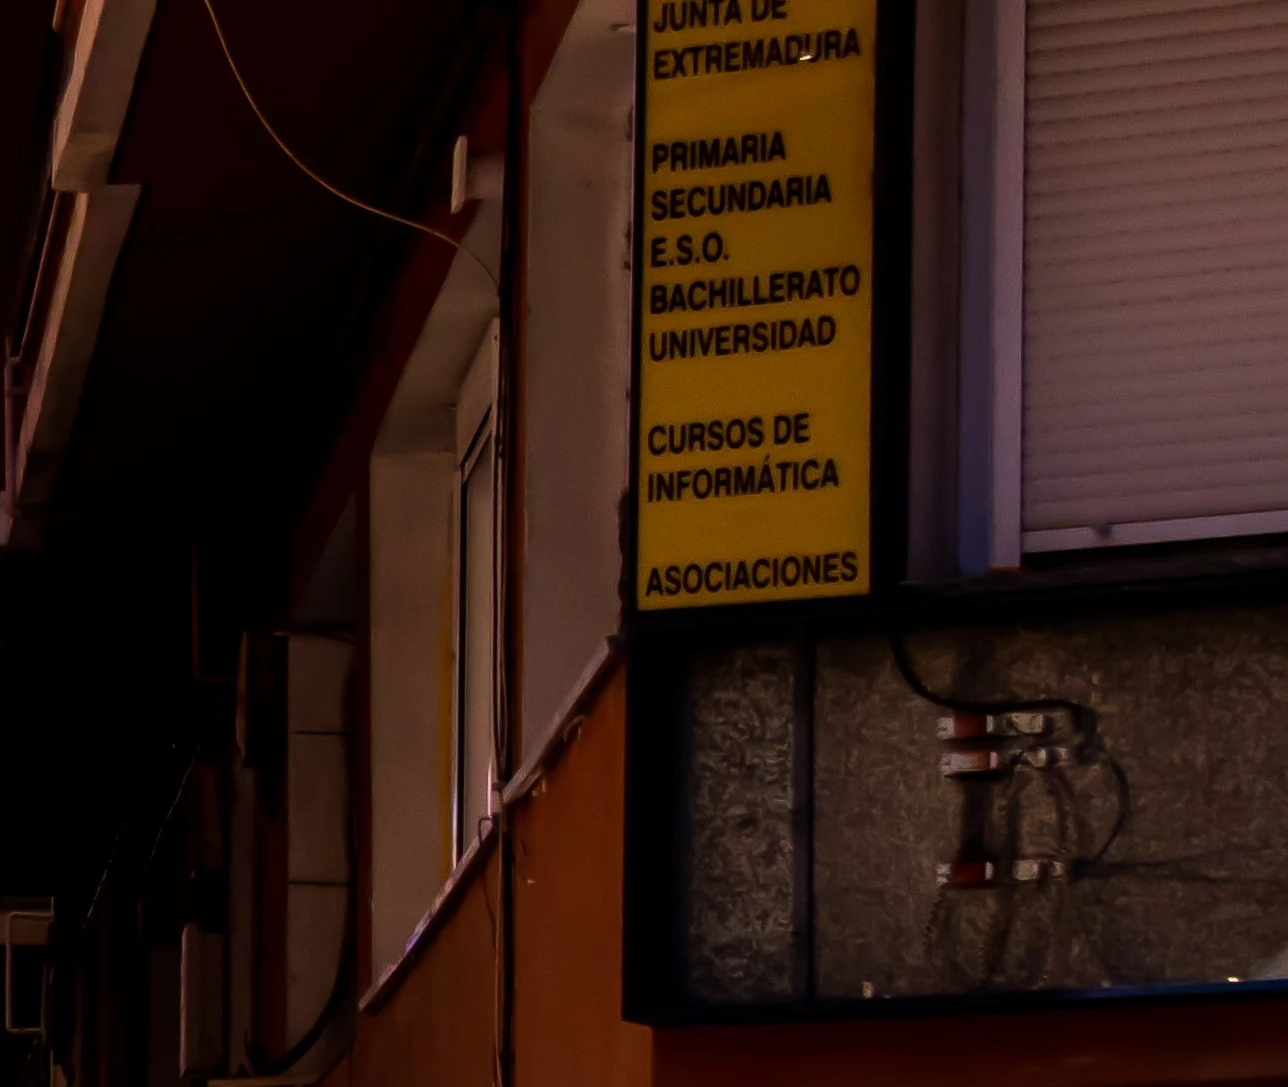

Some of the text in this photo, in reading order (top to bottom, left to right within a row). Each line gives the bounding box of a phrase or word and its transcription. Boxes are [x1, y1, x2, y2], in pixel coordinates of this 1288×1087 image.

[654, 0, 787, 33] JUNTA DE
[654, 28, 861, 80] EXTREMADURA
[653, 132, 787, 173] PRIMARIA
[651, 174, 832, 221] SECUNDARIA
[650, 232, 730, 268] E.S.O.
[650, 265, 861, 315] BACHILLERATO
[649, 316, 836, 362] UNIVERSIDAD
[647, 413, 810, 456] CURSOS DE
[647, 454, 839, 502] INFORMÁTICA
[645, 551, 859, 597] ASOCIACIONES
